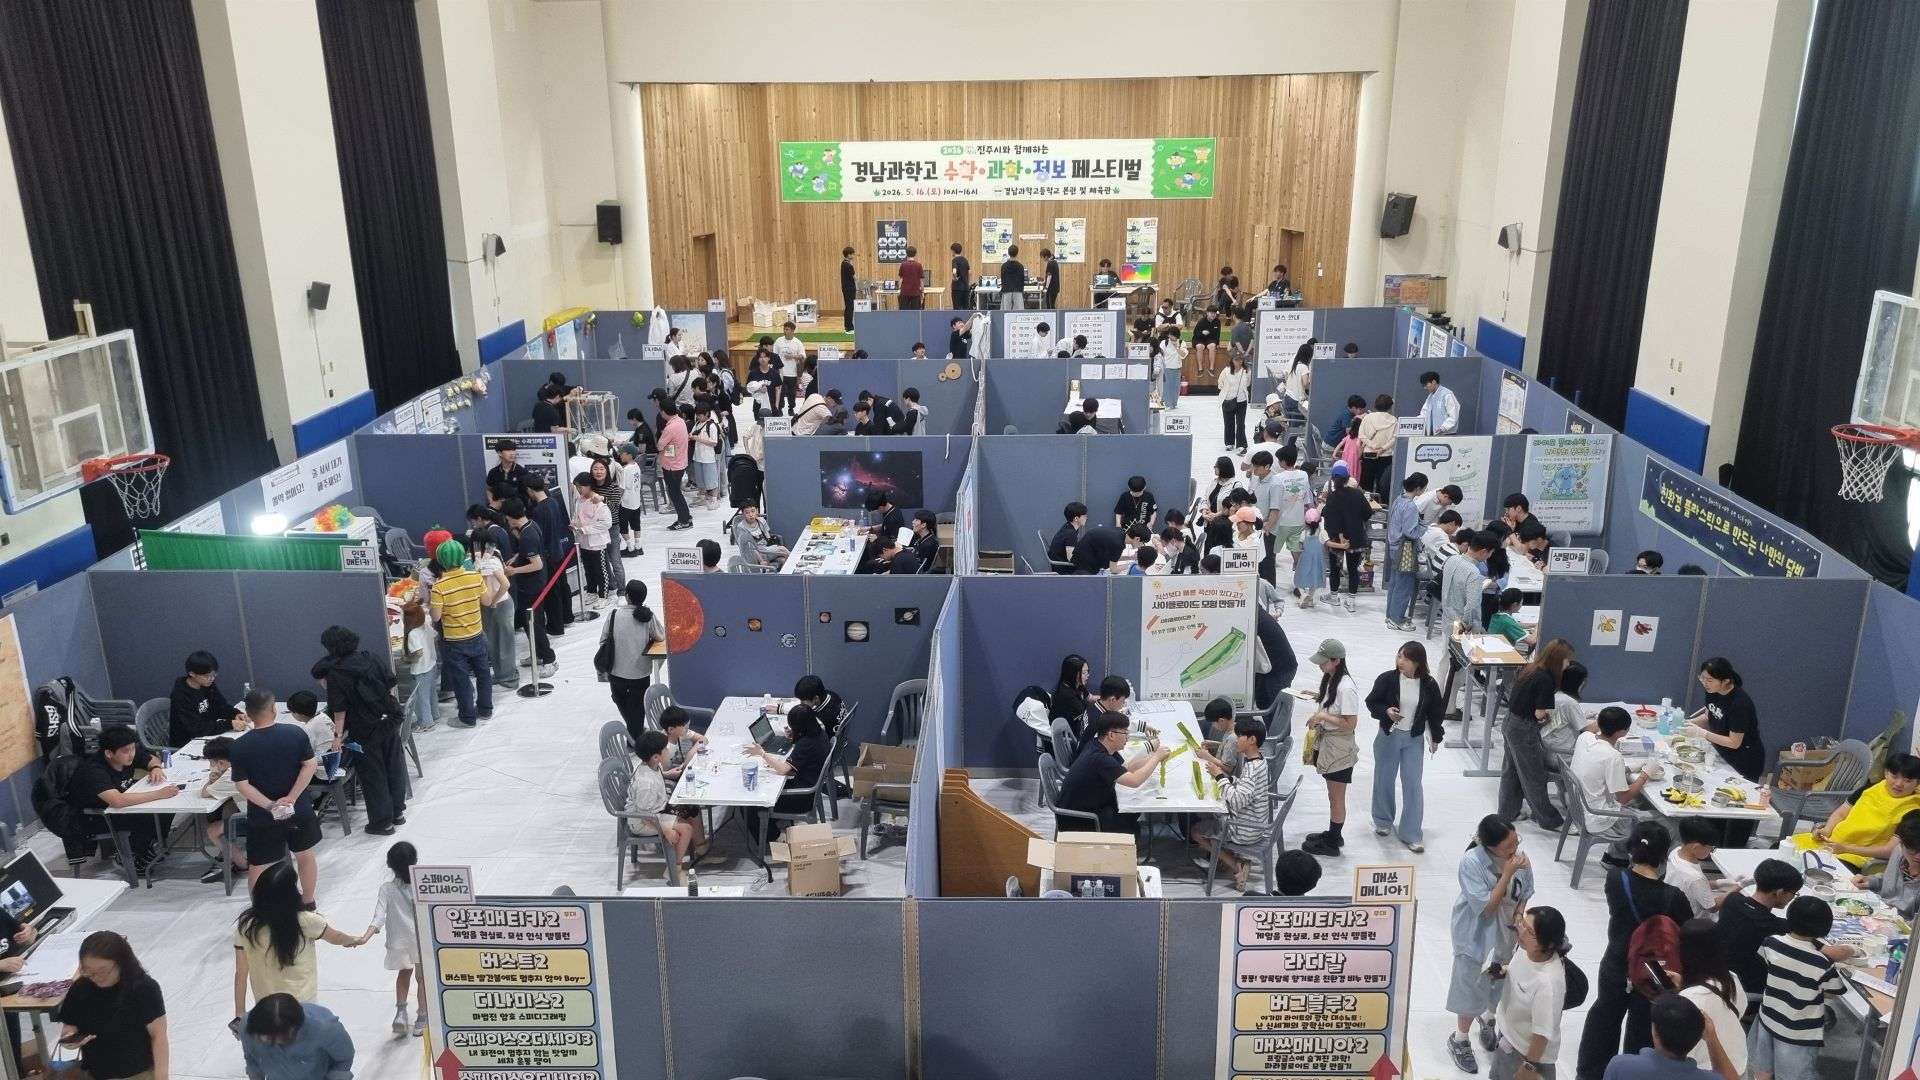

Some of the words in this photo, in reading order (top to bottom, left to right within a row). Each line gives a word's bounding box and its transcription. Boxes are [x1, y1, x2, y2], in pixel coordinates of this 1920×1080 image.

[977, 145, 1010, 155] 진주시와
[1014, 144, 1049, 155] 함께하는
[851, 161, 938, 183] 경남과학고
[1071, 159, 1142, 181] 페스티벌
[1004, 186, 1060, 196] 경남과학고등학교
[1660, 482, 1682, 512] 친환경
[1683, 498, 1730, 535] 플라스틱으로
[1732, 526, 1757, 556] 만드는
[1759, 541, 1786, 568] 나만의
[351, 550, 367, 559] 인포
[672, 551, 697, 559] 스페이스
[1232, 552, 1247, 560] 매쓰
[1553, 552, 1585, 562] 생물마을
[1565, 561, 1571, 569] 3
[1154, 590, 1182, 600] 직선보다
[1219, 590, 1244, 598] 있다고?
[1152, 600, 1200, 610] 사이클로이드
[1201, 599, 1218, 609] 모형
[421, 874, 464, 884] 스페이스
[1372, 871, 1399, 884] 매쓰
[418, 885, 470, 895] 오디세이2
[1360, 884, 1409, 897] 매니아1
[446, 908, 561, 930] 인포매티카2
[1252, 909, 1369, 931] 인포매티카2
[452, 930, 477, 940] 게임을
[508, 931, 523, 940] 모션
[526, 931, 543, 941] 인식
[545, 931, 571, 941] 템플런
[1256, 931, 1281, 941] 게임을
[1284, 931, 1311, 941] 현실로,
[1313, 931, 1329, 941] 모션
[1331, 931, 1348, 941] 인식
[1350, 931, 1377, 941] 템플런
[480, 952, 549, 970] 버스트2
[1284, 952, 1347, 974] 라디칼
[445, 974, 474, 982] 버스트는
[476, 974, 517, 983] 빨간불에도
[519, 974, 543, 983] 멈추지
[544, 975, 562, 984] 않아
[1260, 974, 1289, 984] 알록달록
[1291, 974, 1320, 984] 향기로운
[1322, 974, 1346, 984] 친환경
[1347, 974, 1362, 984] 비누
[1363, 974, 1387, 984] 만들기
[474, 992, 565, 1009] 디나미스2
[1269, 994, 1357, 1015] 버그블루2
[472, 1013, 497, 1022] 마법진
[499, 1013, 516, 1022] 암호
[1284, 1014, 1313, 1022] 라이트의
[1266, 1022, 1299, 1030] 신세계의
[453, 1032, 594, 1047] 스페이스오디세이3
[1254, 1037, 1369, 1054] 매쓰매니아2
[468, 1049, 478, 1057] 내
[480, 1049, 505, 1058] 회전이
[508, 1049, 531, 1058] 멈추지
[533, 1049, 550, 1058] 않는
[497, 1057, 514, 1065] 세차
[1307, 1055, 1329, 1063] 숨겨진
[1331, 1055, 1351, 1063] 과학!
